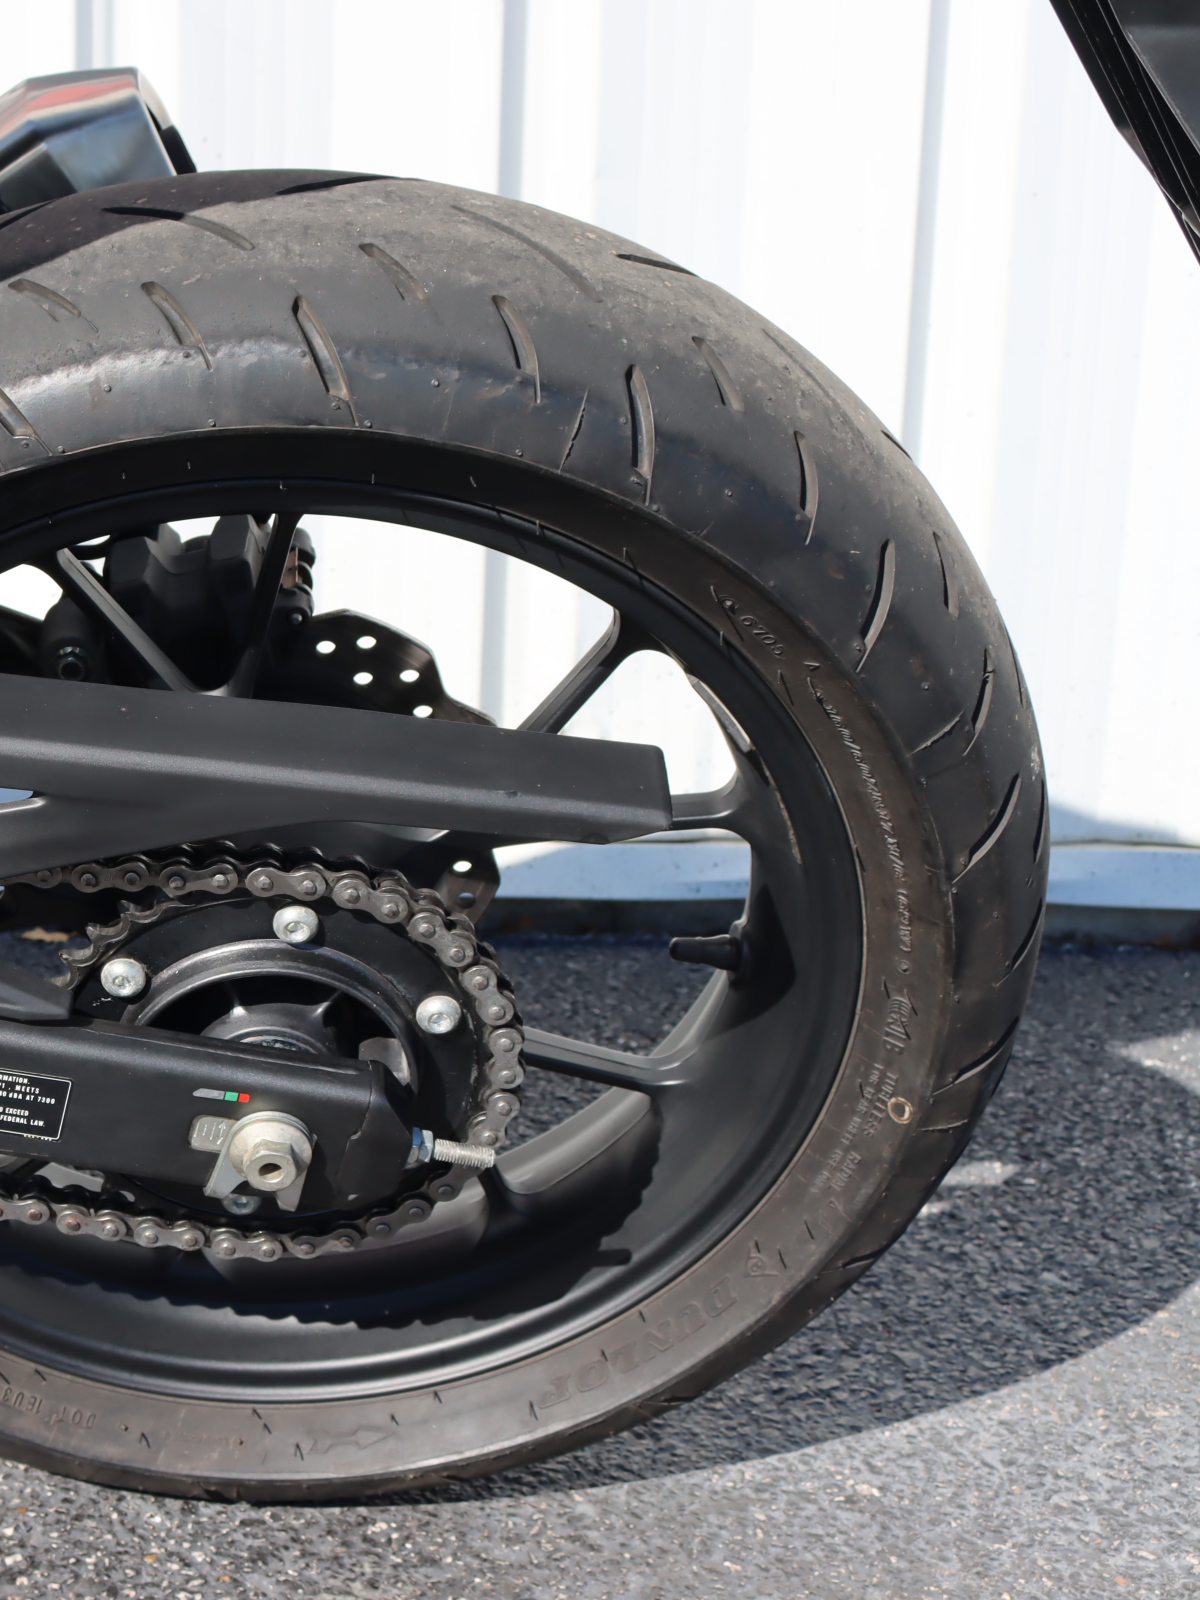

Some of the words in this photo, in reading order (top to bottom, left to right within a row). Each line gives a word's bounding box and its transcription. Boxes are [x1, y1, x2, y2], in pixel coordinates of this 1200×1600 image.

[735, 609, 791, 659] 6705
[9, 1092, 23, 1100] dBA
[37, 1096, 56, 1105] 7300
[15, 1085, 40, 1094] MEETS
[0, 1114, 28, 1124] FEDERAL
[30, 1119, 46, 1127] LAW.
[5, 1107, 29, 1117] EXCEED
[823, 1150, 865, 1195] RADIAL
[522, 1272, 751, 1414] DUNLOP
[53, 1403, 100, 1432] DOT
